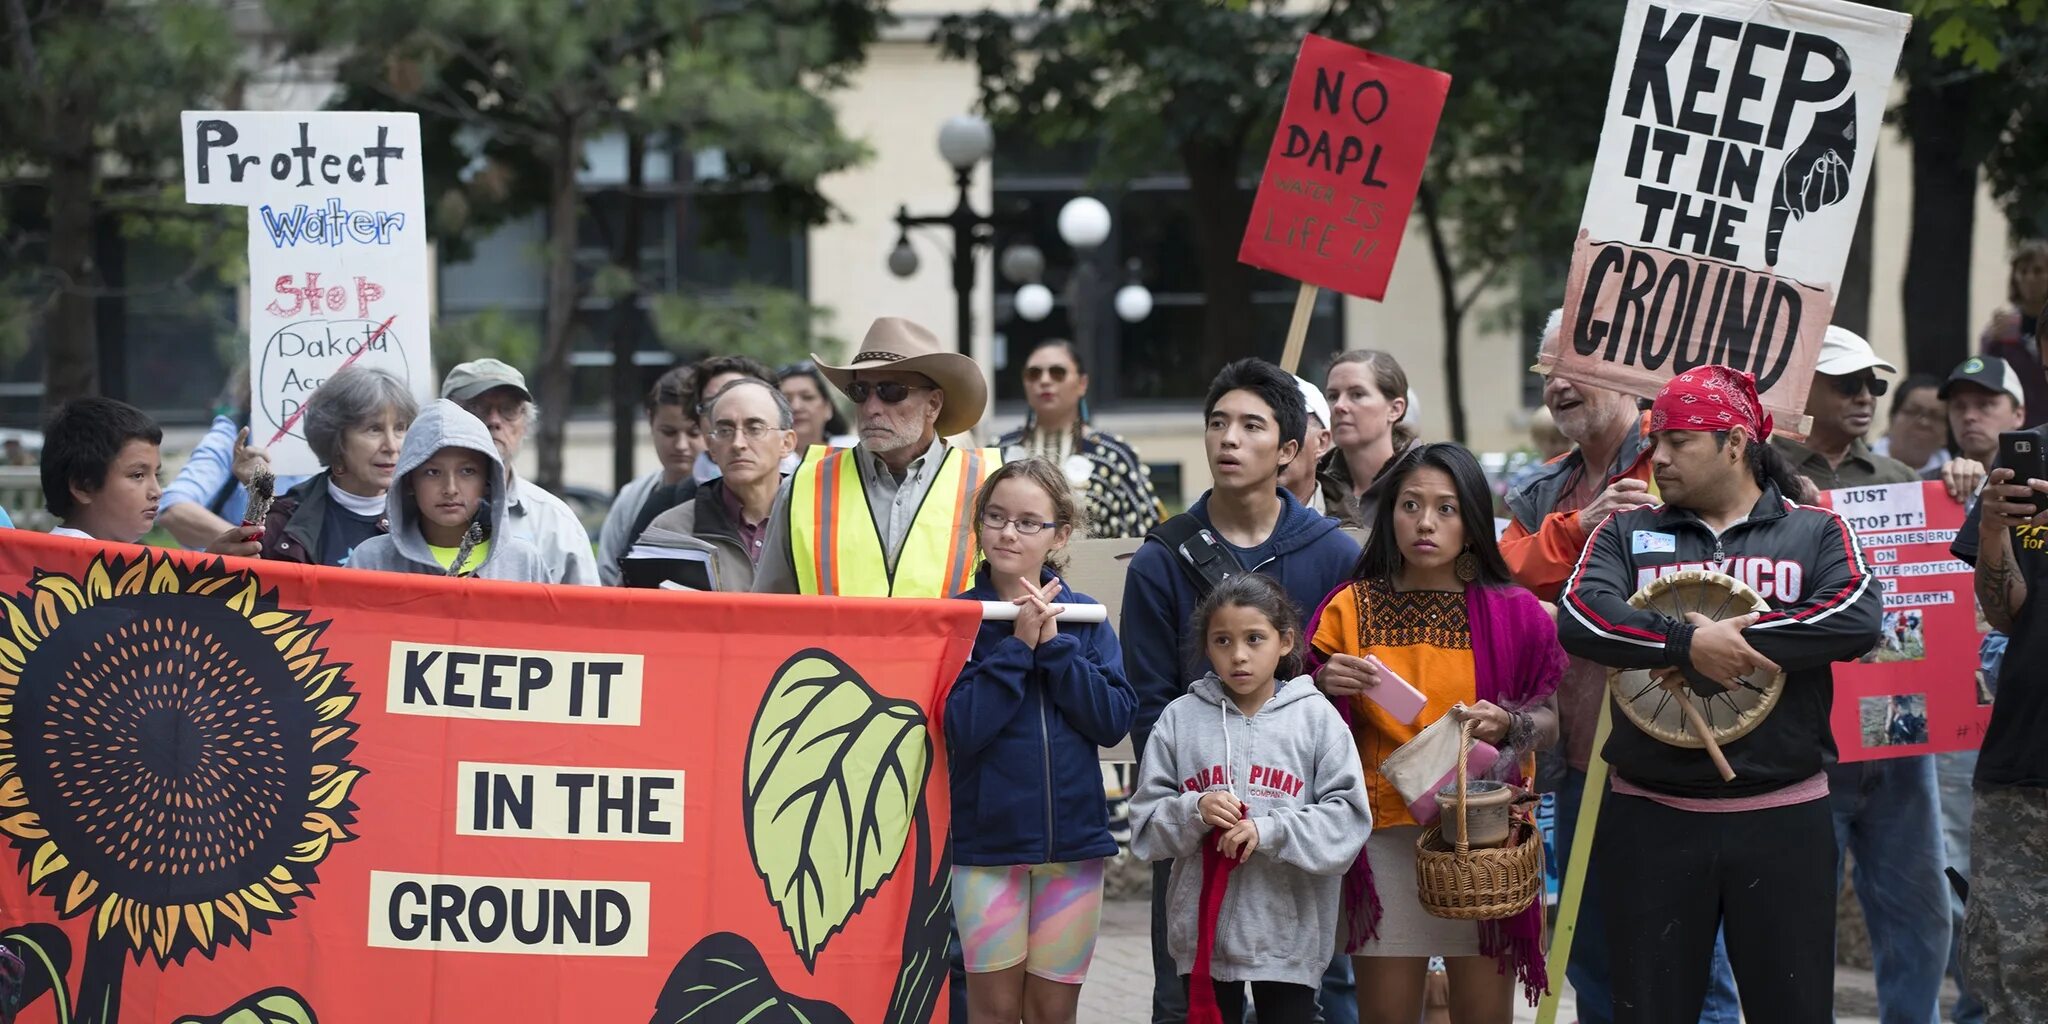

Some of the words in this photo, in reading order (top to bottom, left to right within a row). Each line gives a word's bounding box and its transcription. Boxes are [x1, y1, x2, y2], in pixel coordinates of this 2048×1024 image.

[1313, 67, 1388, 125] NO
[1622, 4, 1852, 150] KEEP
[197, 119, 404, 187] Protect
[1280, 125, 1388, 189] DAPL
[1624, 125, 1690, 185] IT
[1696, 139, 1765, 203] IN
[260, 198, 405, 248] Water
[1273, 172, 1334, 205] WATER
[1342, 196, 1385, 230] IS
[1635, 184, 1748, 262] THE
[266, 271, 385, 318] Stop
[1573, 246, 1802, 395] GROUND
[279, 324, 387, 358] Dakota
[1843, 489, 1888, 504] JUST
[1896, 513, 1914, 526] IT
[1859, 532, 1925, 547] CENARIES
[1871, 565, 1900, 576] TIVE
[1903, 561, 1970, 573] PROTECTO
[1876, 550, 1896, 562] ON
[403, 650, 553, 710] KEEP
[569, 661, 623, 718] IT
[473, 771, 534, 830] IN
[556, 773, 675, 835] THE
[1249, 764, 1304, 798] PINAY
[389, 881, 631, 946] GROUND
